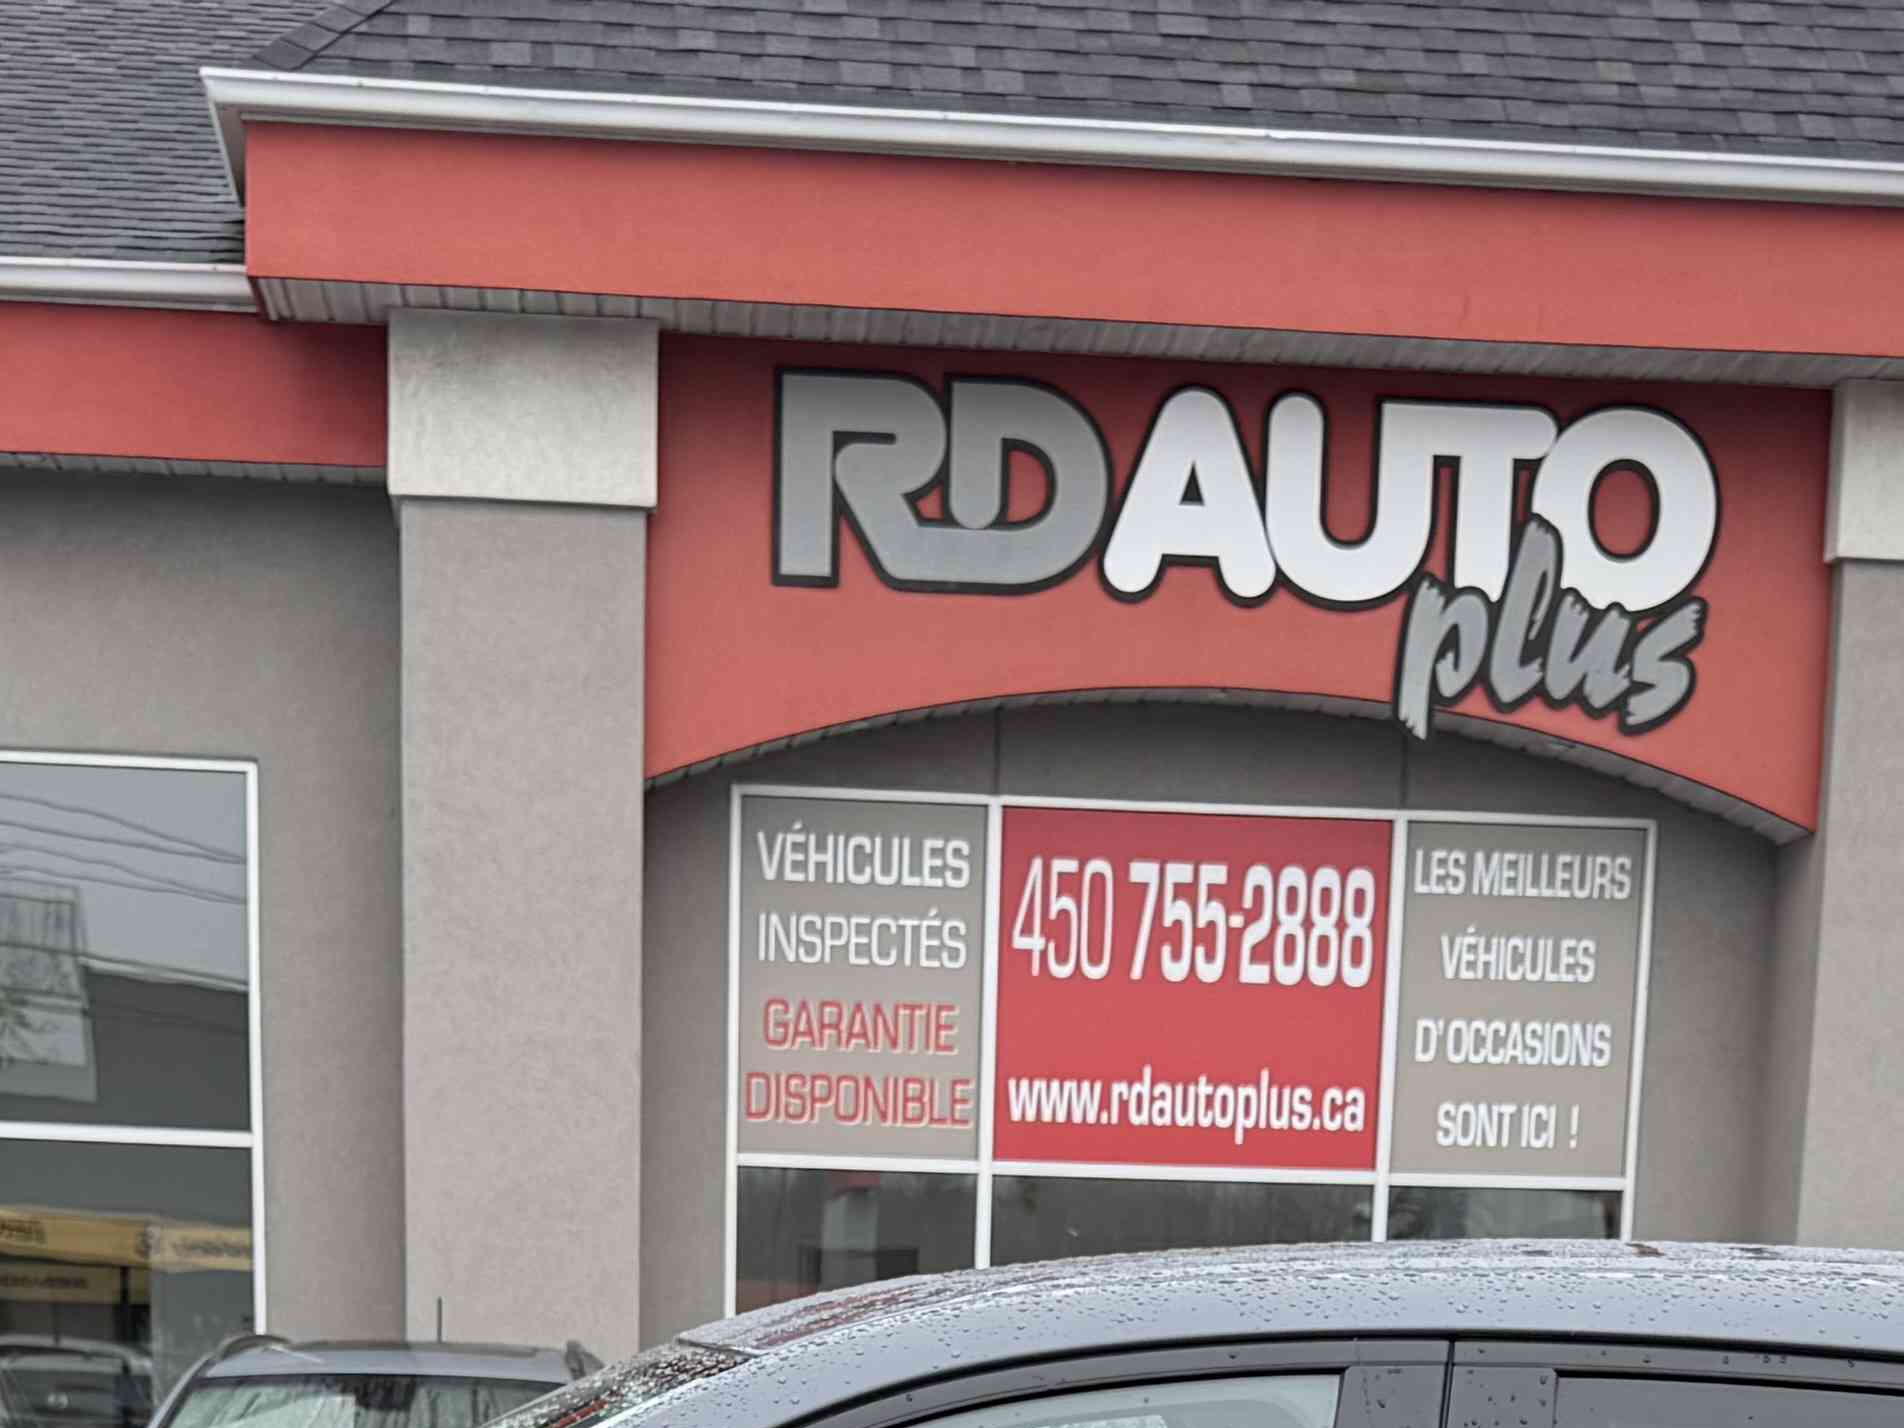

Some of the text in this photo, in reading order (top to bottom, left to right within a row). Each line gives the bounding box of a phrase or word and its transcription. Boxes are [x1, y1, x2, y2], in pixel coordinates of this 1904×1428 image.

[1395, 512, 1706, 741] plus
[756, 820, 971, 889] VÉHICULES
[1413, 847, 1633, 901] LES MEILLEURS
[757, 907, 968, 969] INSPECTÉS
[1011, 856, 1376, 988] 450 755-2888
[1440, 923, 1597, 984] VÉHICULES
[763, 996, 961, 1057] GARANTIE
[745, 1071, 975, 1129] DISPONIBLE
[1007, 1064, 1367, 1145] www.rdautoplus.ca
[1435, 1101, 1518, 1149] SONT
[1520, 1103, 1557, 1150] ICI
